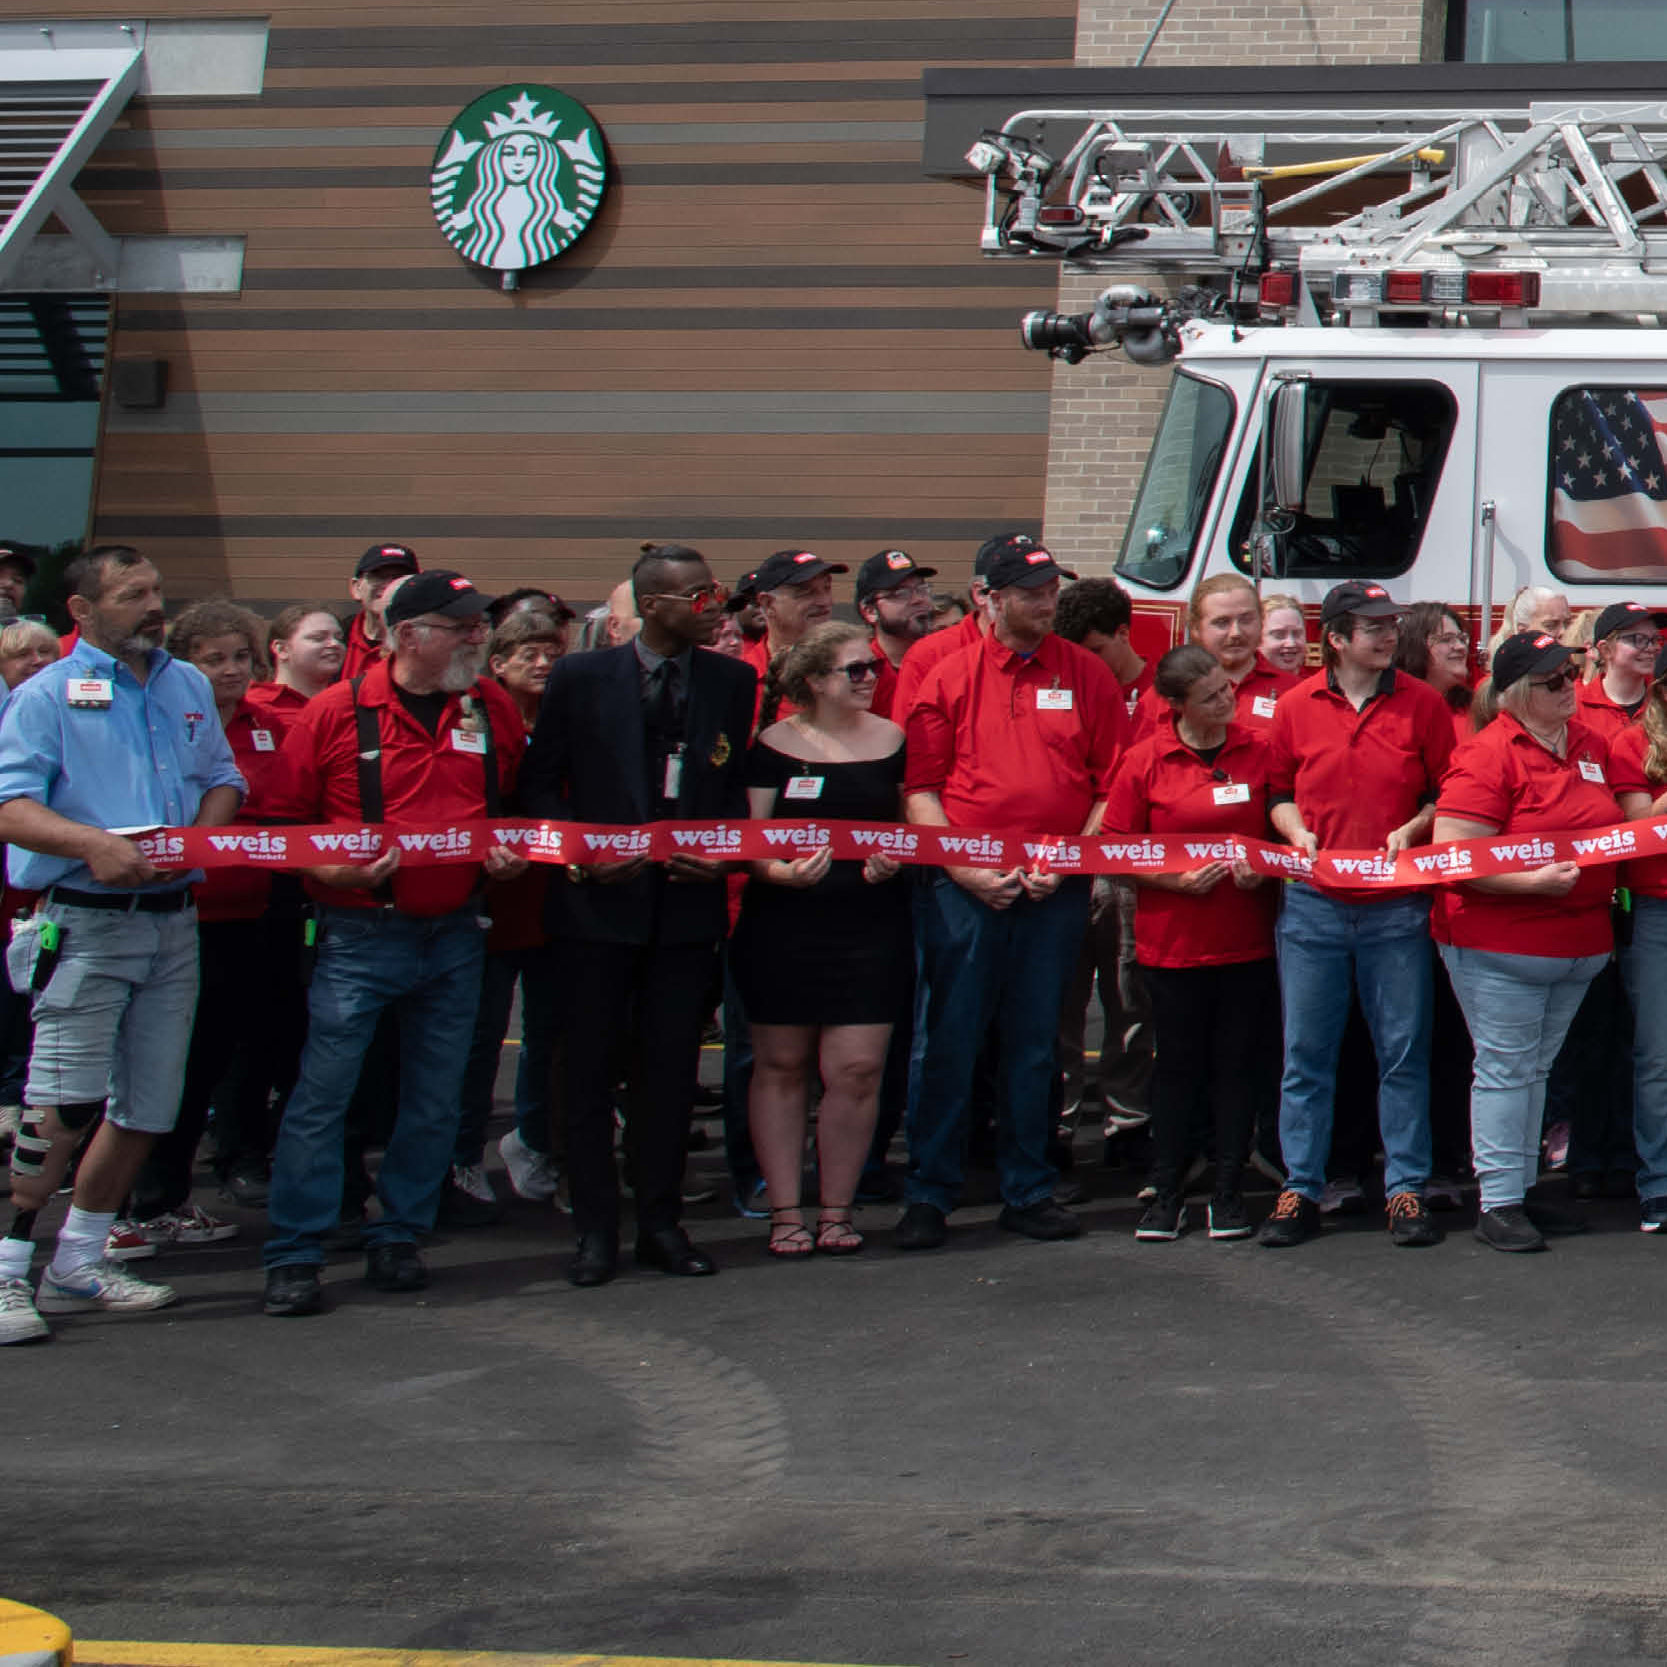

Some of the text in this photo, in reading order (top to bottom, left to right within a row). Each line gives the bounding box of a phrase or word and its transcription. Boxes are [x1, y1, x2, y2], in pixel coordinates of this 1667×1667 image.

[138, 832, 184, 855] eis
[207, 831, 287, 853] weis
[397, 827, 472, 849] weis
[493, 824, 563, 846] weis
[583, 830, 652, 850] weis
[671, 825, 742, 846] weis
[762, 824, 830, 845] weis
[851, 828, 918, 849] weis
[938, 834, 1004, 855] weis
[1571, 829, 1635, 855] weis
[1023, 841, 1081, 860] weis
[1100, 839, 1165, 860] weis
[1184, 839, 1247, 860] weis
[1413, 846, 1472, 870] weis
[1490, 838, 1555, 861] weis
[1331, 855, 1396, 875] weis
